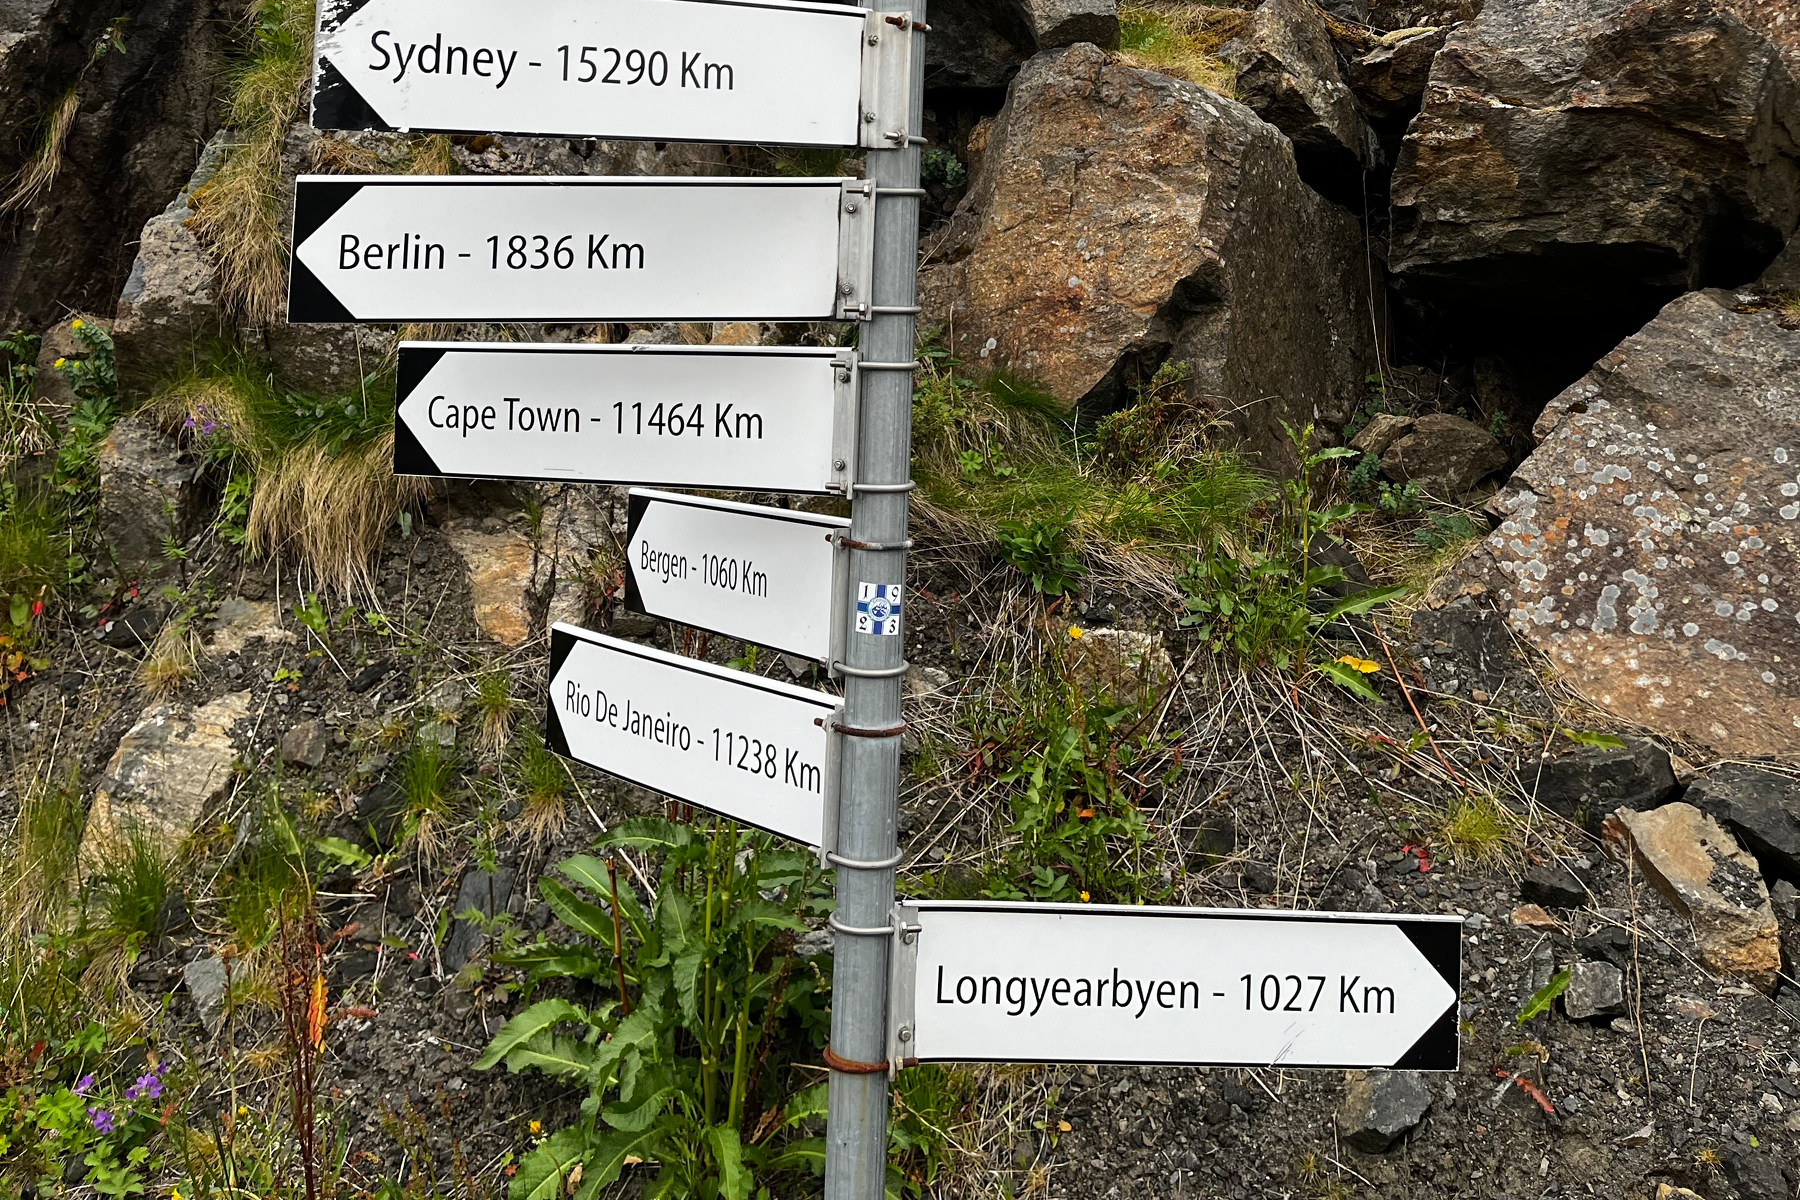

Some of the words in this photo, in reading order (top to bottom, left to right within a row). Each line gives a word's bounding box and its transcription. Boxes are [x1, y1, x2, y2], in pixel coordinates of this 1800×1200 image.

[368, 30, 518, 90] Sydney
[557, 44, 668, 87] 15290
[681, 51, 734, 91] Km
[339, 232, 445, 270] Berlin
[486, 234, 575, 270] 1836
[587, 233, 645, 270] Km
[428, 395, 496, 438] Cape
[503, 397, 580, 433] Town
[612, 401, 705, 437] 11464
[715, 402, 763, 440] Km
[641, 539, 687, 584] Bergen
[702, 553, 738, 591] 1060
[742, 559, 767, 598] Km
[566, 680, 591, 718] Rio
[595, 690, 618, 728] De
[622, 699, 691, 752] Janeiro
[712, 727, 777, 779] 11238
[784, 747, 821, 794] Km
[936, 965, 1199, 1020] Longyearbyen
[1240, 973, 1326, 1012] 1027
[1339, 975, 1395, 1014] Km
